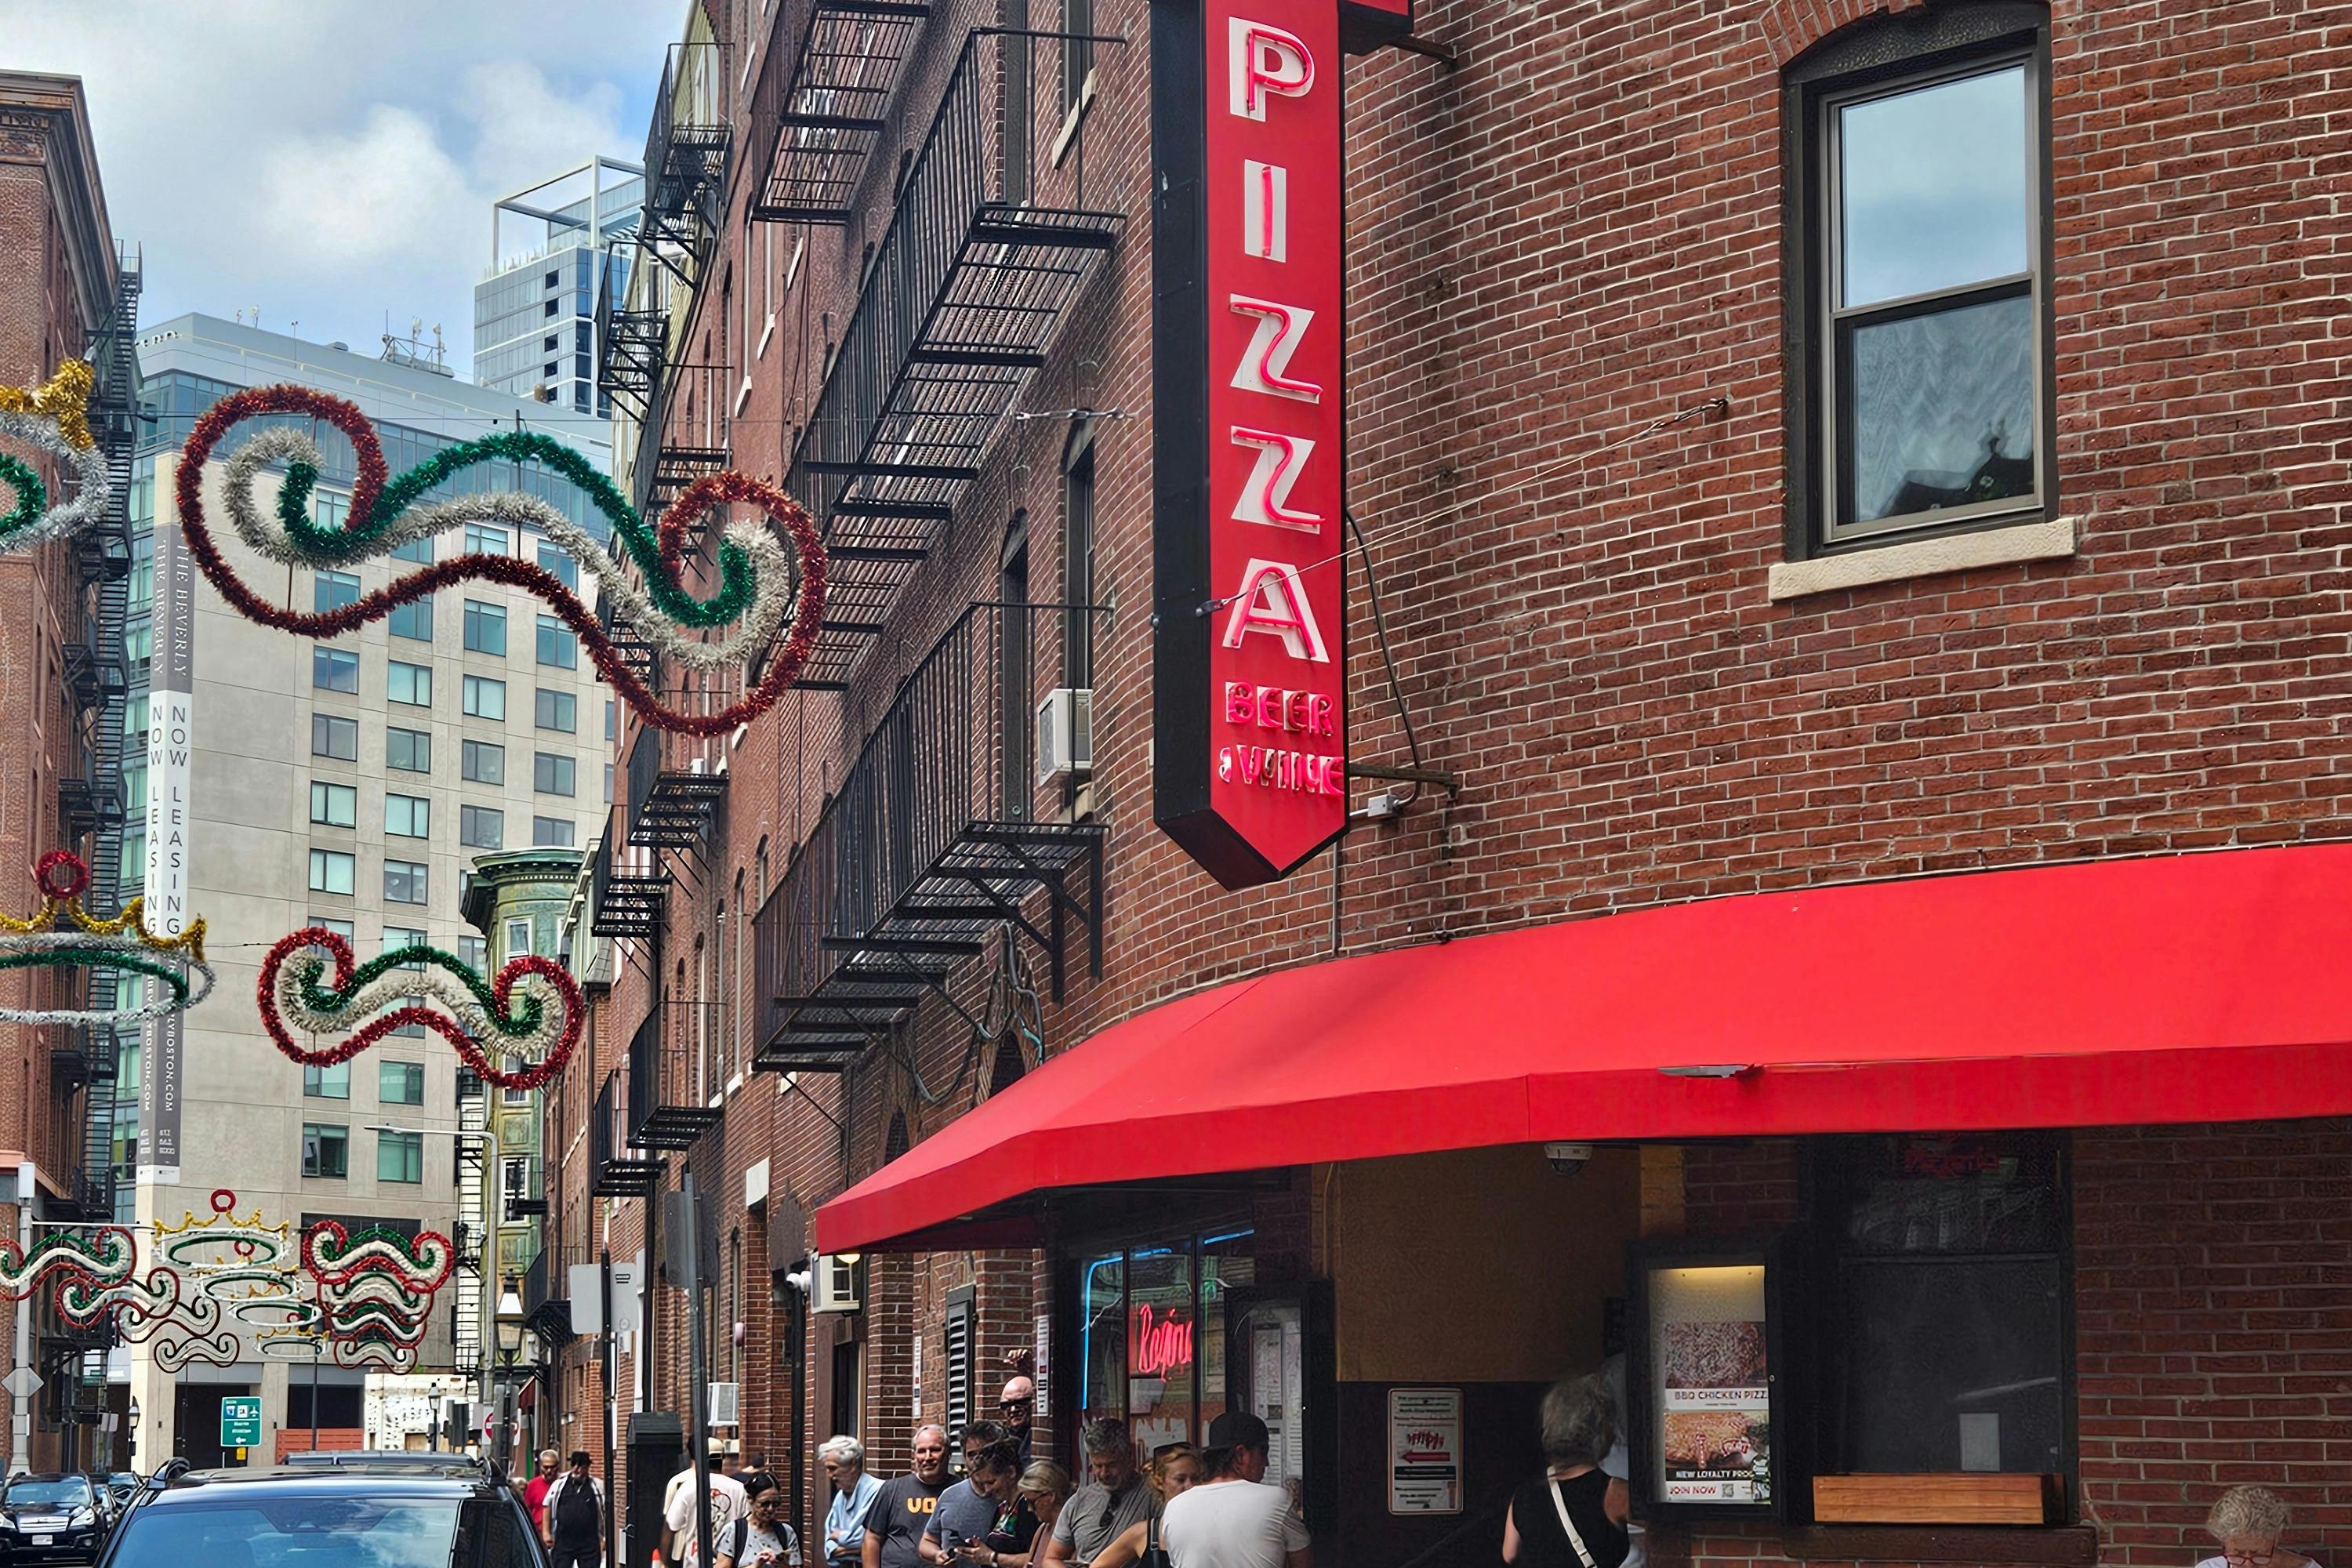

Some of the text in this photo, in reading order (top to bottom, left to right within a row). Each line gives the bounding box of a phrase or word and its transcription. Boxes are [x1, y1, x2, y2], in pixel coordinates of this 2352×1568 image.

[1221, 16, 1330, 664] PIZZA
[174, 588, 189, 677] BEVERLY
[1225, 681, 1334, 737] BEER
[147, 705, 163, 936] NOW LEASING
[165, 706, 187, 935] NOW LEASING
[1698, 1390, 1742, 1399] CHICKEN
[1669, 1486, 1717, 1495] JOIN NOW
[1697, 1470, 1731, 1479] LOYALTY
